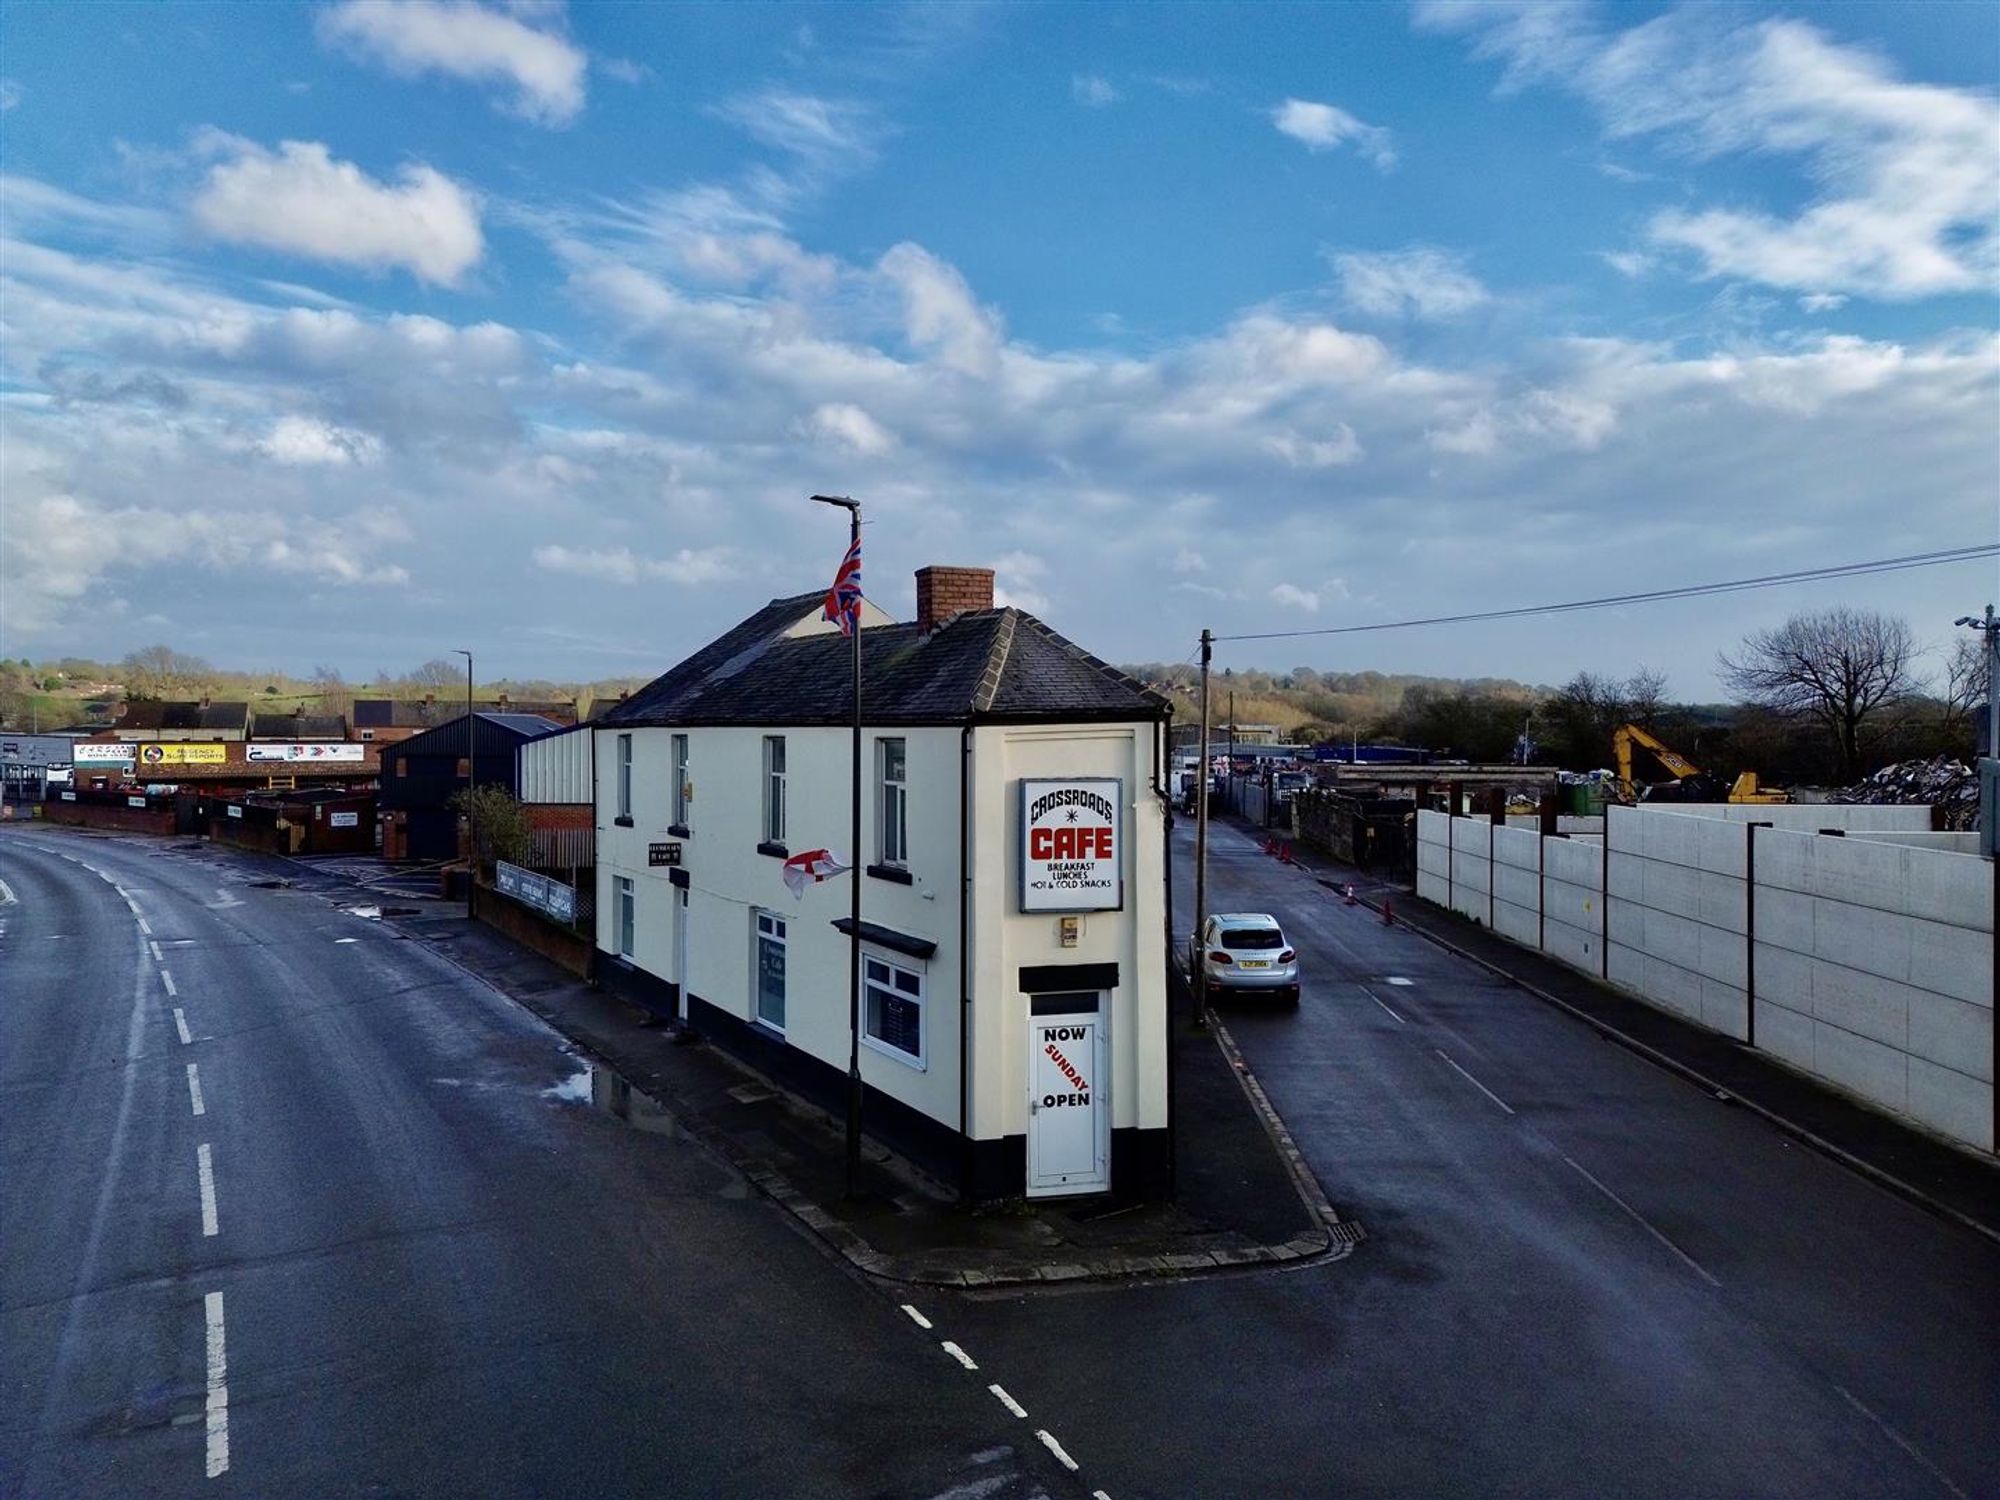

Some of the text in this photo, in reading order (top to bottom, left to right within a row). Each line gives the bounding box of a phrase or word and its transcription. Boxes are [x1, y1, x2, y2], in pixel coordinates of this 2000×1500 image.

[1031, 789, 1112, 825] CROSSROADS
[1031, 827, 1112, 860] CAFE
[1047, 862, 1095, 872] BREAKFAST
[1052, 871, 1088, 880] LUNCHES
[1030, 879, 1112, 889] HOT & COLD SNACKS
[1044, 1027, 1087, 1042] NOW
[1044, 1044, 1089, 1091] SUNDAY
[1043, 1093, 1090, 1108] OPEN
